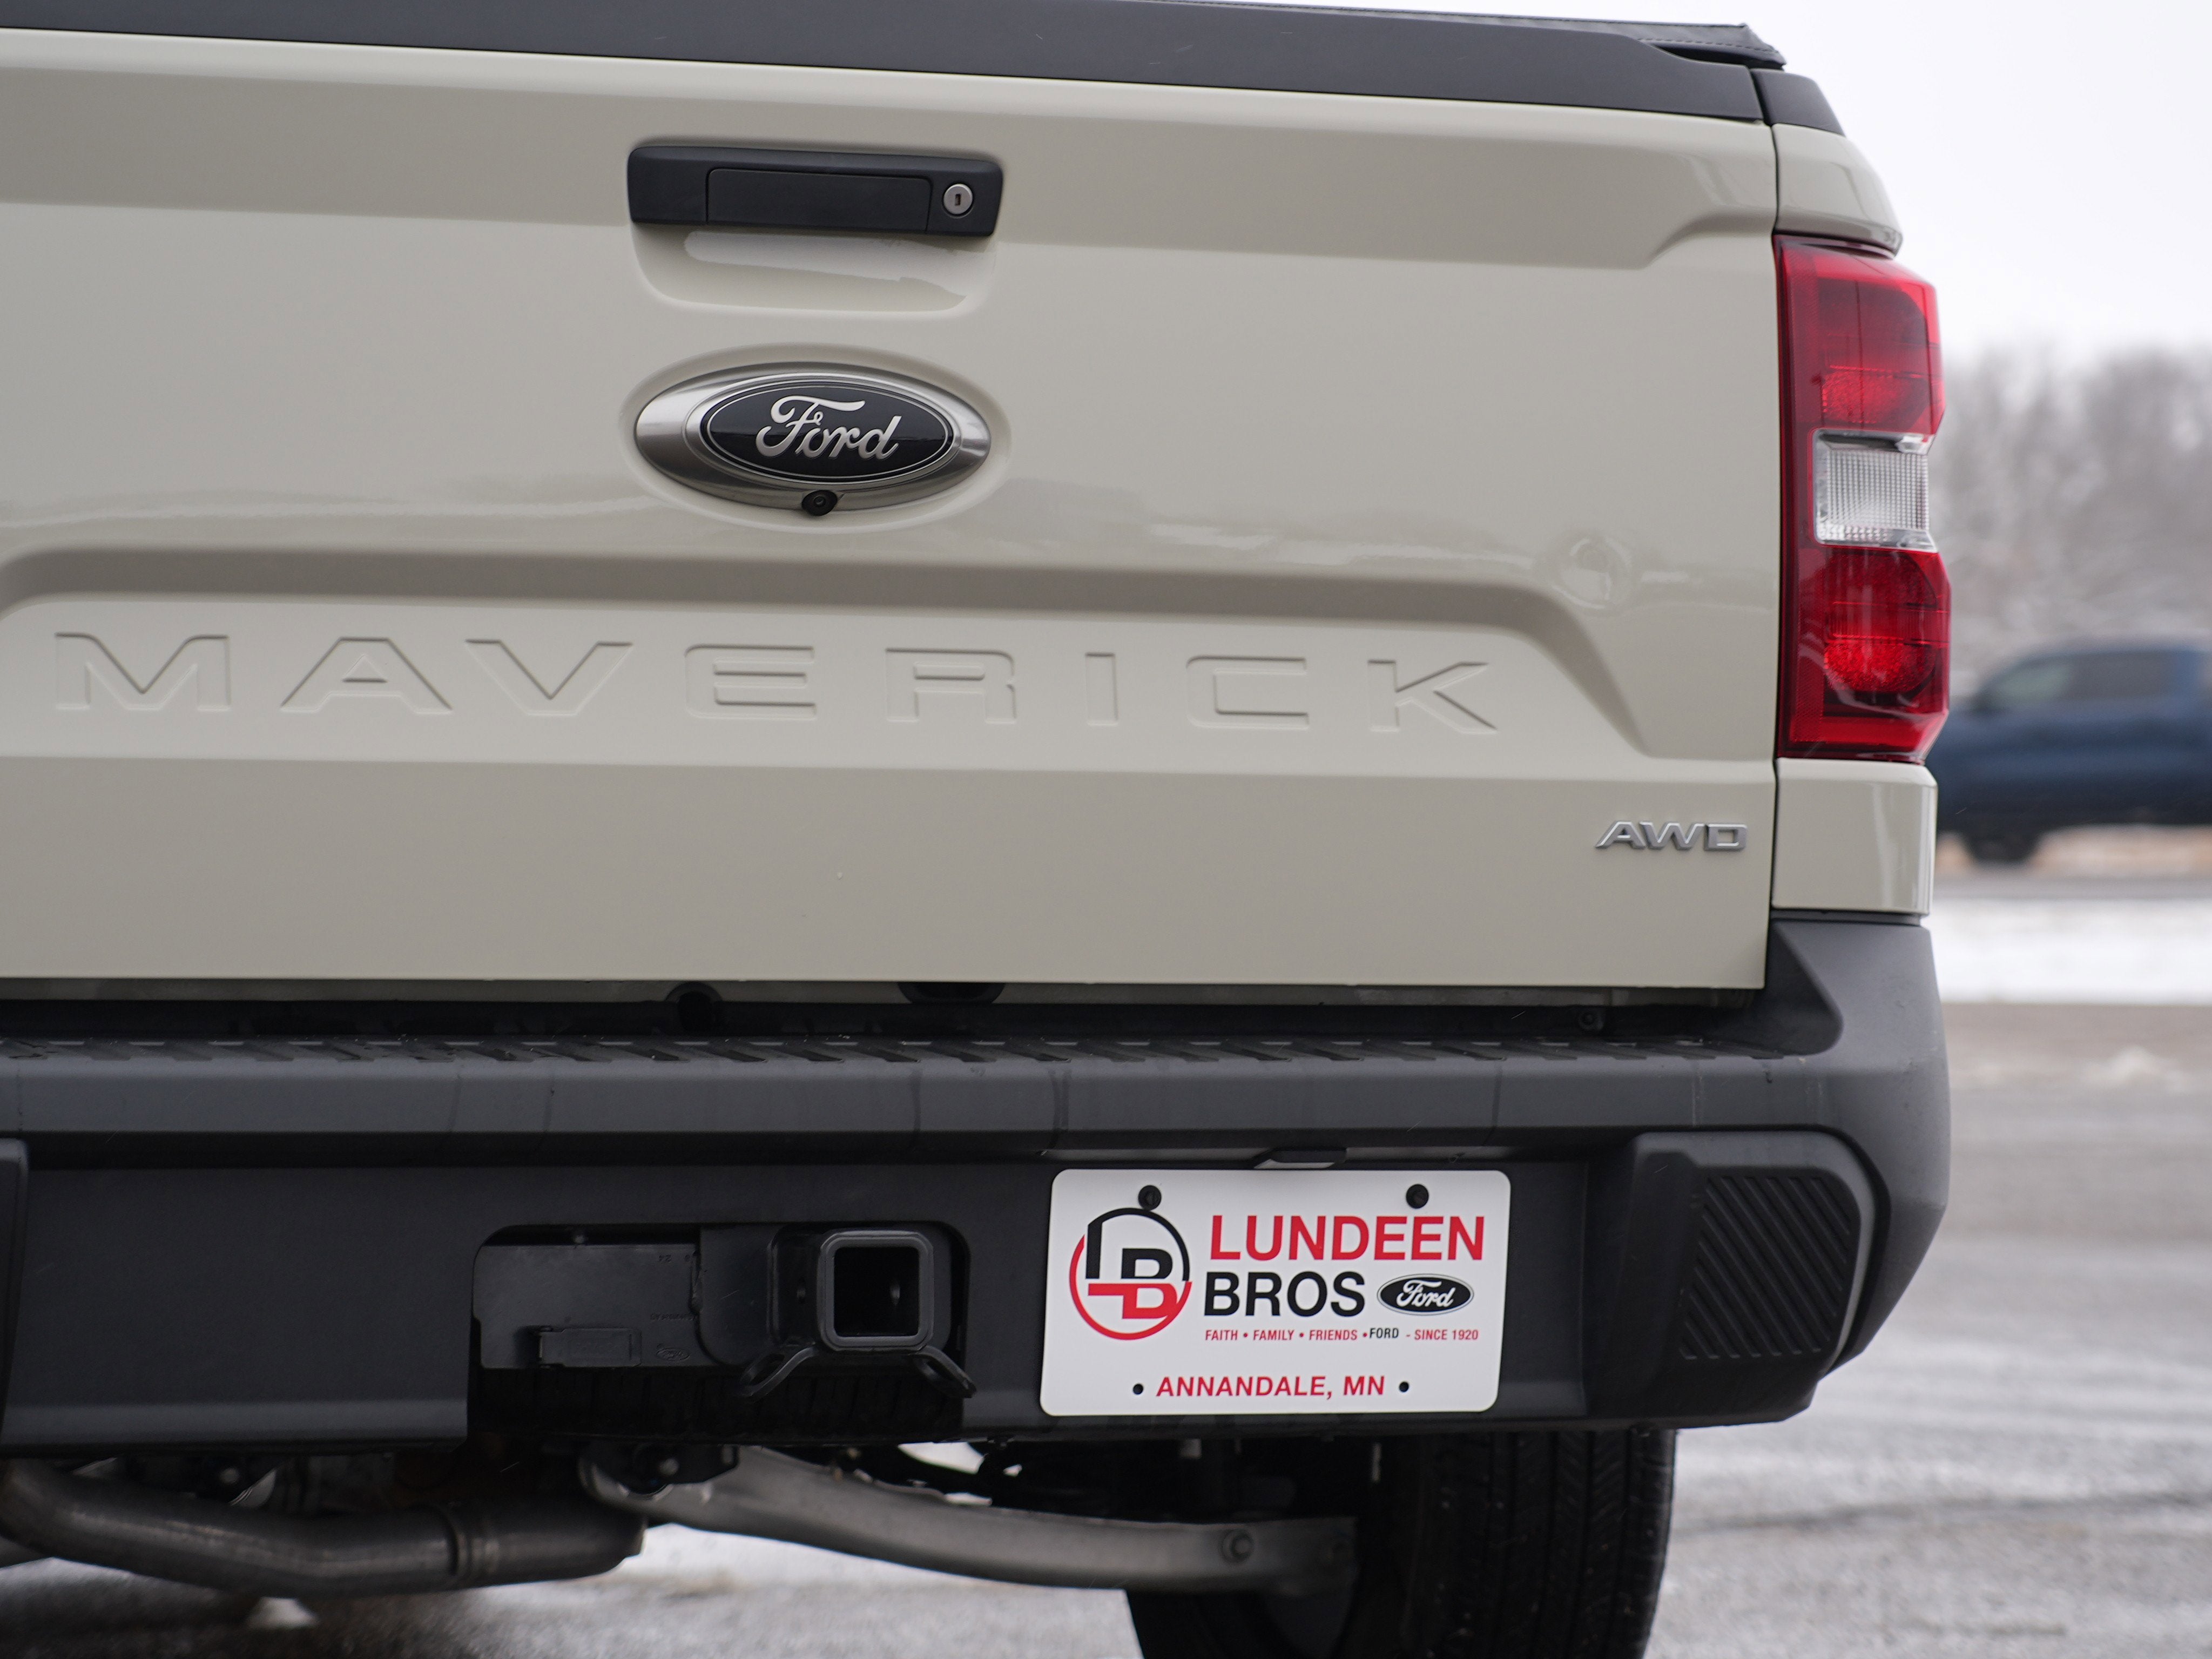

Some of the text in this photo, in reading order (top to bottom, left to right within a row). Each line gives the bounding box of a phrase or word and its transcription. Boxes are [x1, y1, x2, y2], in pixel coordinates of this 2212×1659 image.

[756, 395, 902, 460] Ford
[55, 632, 1499, 734] MAVERICK
[1595, 821, 1748, 851] AWD
[1211, 1215, 1484, 1261] LUNDEEN
[1204, 1271, 1365, 1317] BROS
[1396, 1279, 1454, 1308] Ford
[1206, 1328, 1478, 1340] FAITH FAMILY FRIENDS FORD SINCE 1920
[1156, 1376, 1384, 1399] ANNANDALE, MN
